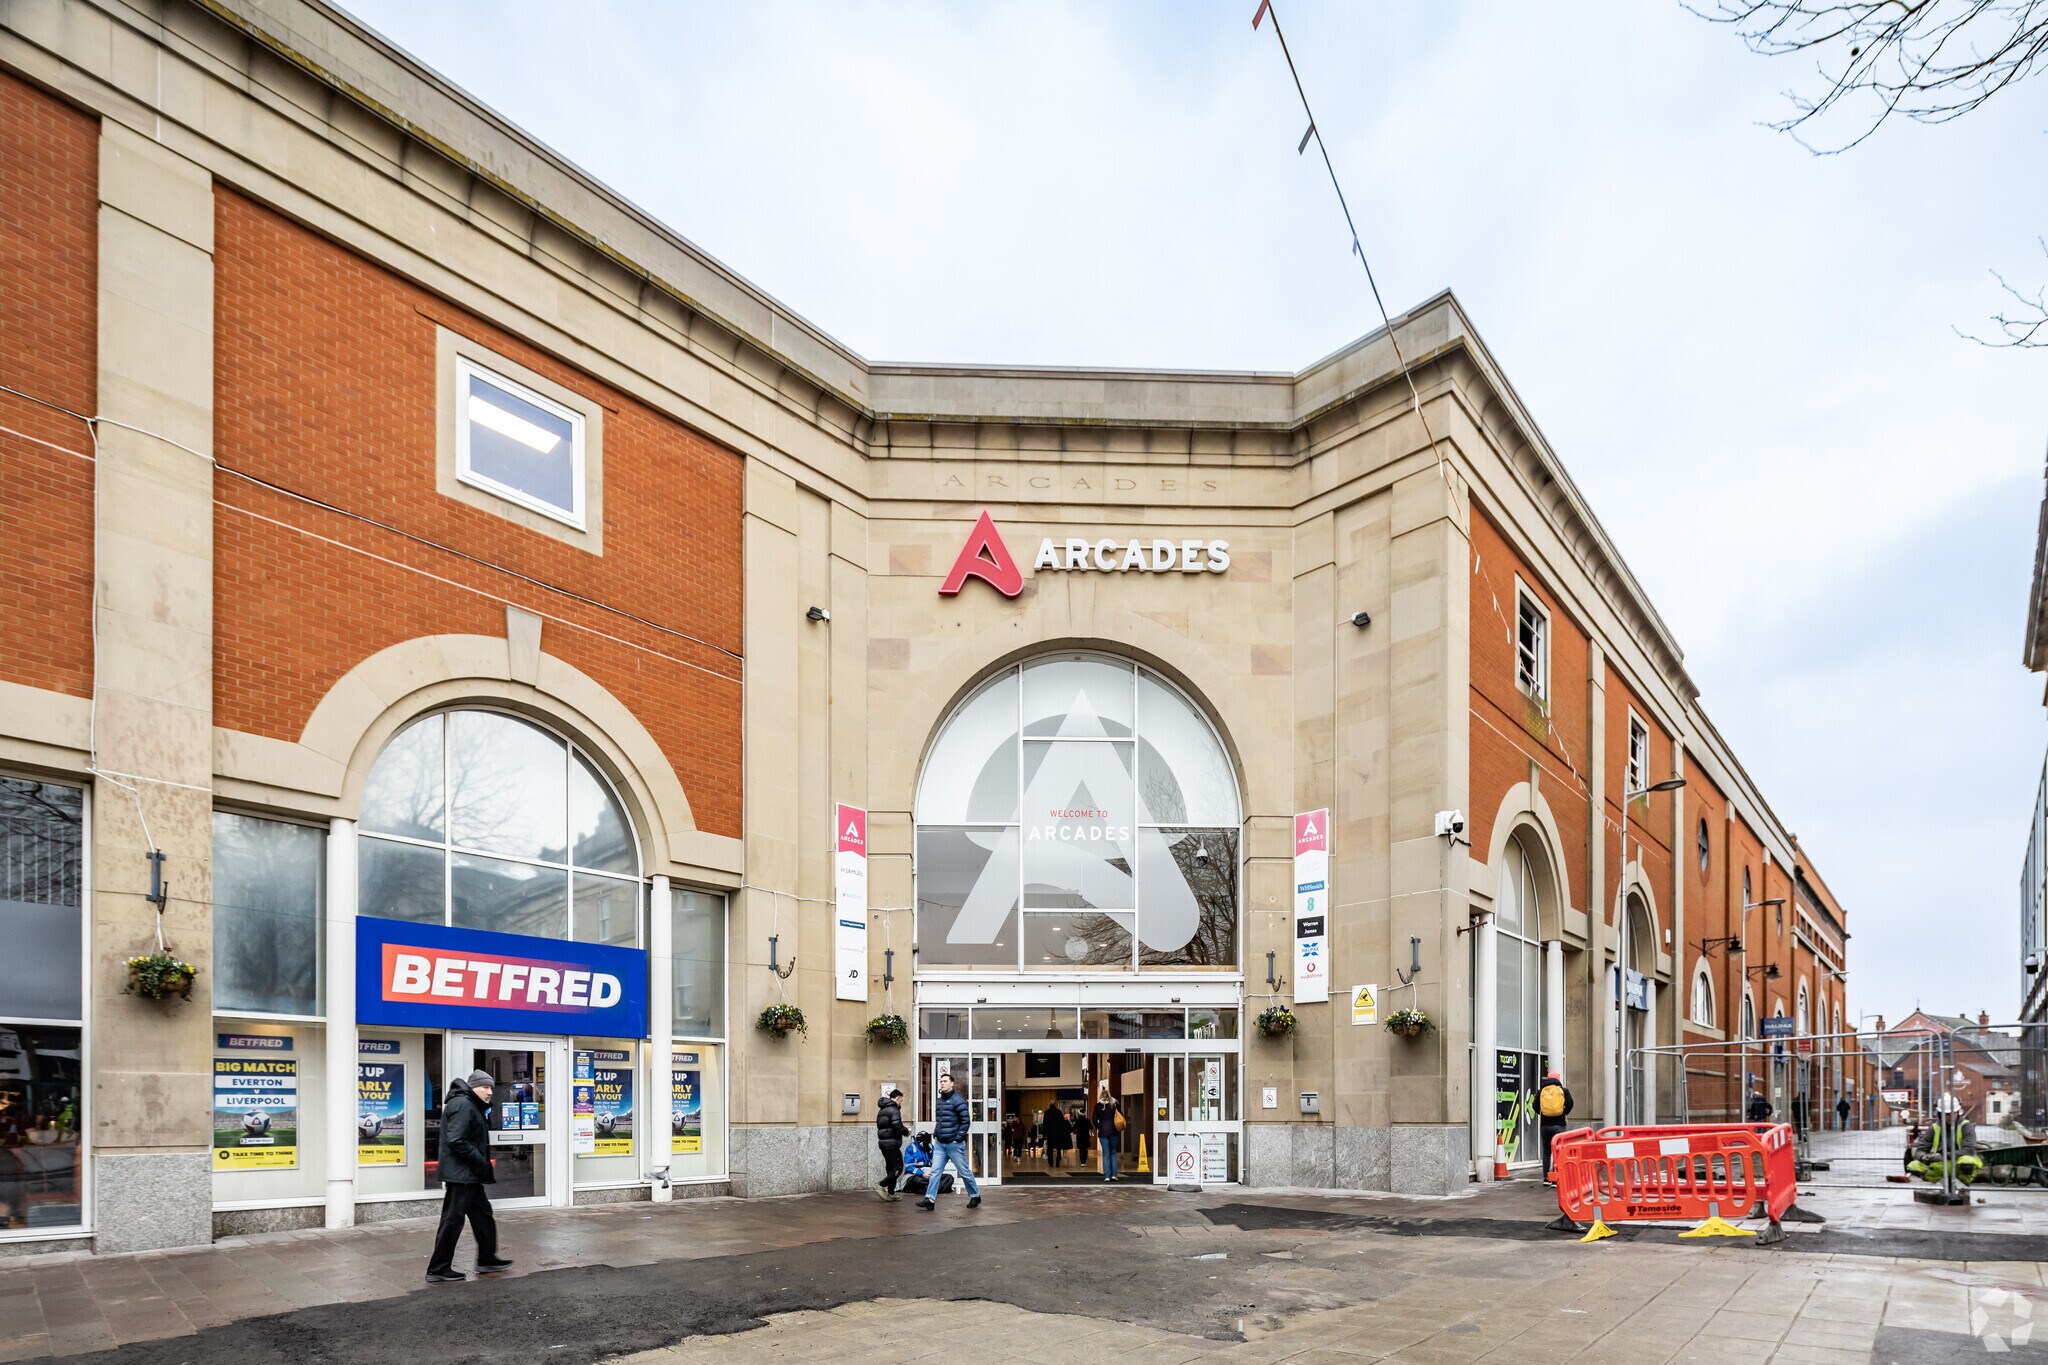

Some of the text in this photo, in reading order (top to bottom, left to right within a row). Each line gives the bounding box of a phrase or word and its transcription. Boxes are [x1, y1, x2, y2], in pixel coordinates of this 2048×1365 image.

[943, 474, 1218, 493] ARCADES
[1034, 537, 1230, 574] ARCADES
[1050, 809, 1108, 818] WELCOME TO
[1028, 826, 1130, 841] ARCADES
[840, 835, 864, 845] ARCADES
[1298, 834, 1324, 844] ARCADES
[848, 969, 858, 979] JD
[392, 954, 622, 1008] BETFRED
[229, 1037, 284, 1048] BETFRED
[216, 1062, 296, 1073] BIG MATCH
[365, 1067, 385, 1077] UP
[595, 1072, 617, 1081] 2 UP
[674, 1073, 687, 1081] UP
[232, 1078, 282, 1086] EVERTON
[358, 1081, 392, 1092] ARLY
[227, 1097, 285, 1105] LIVERPOOL
